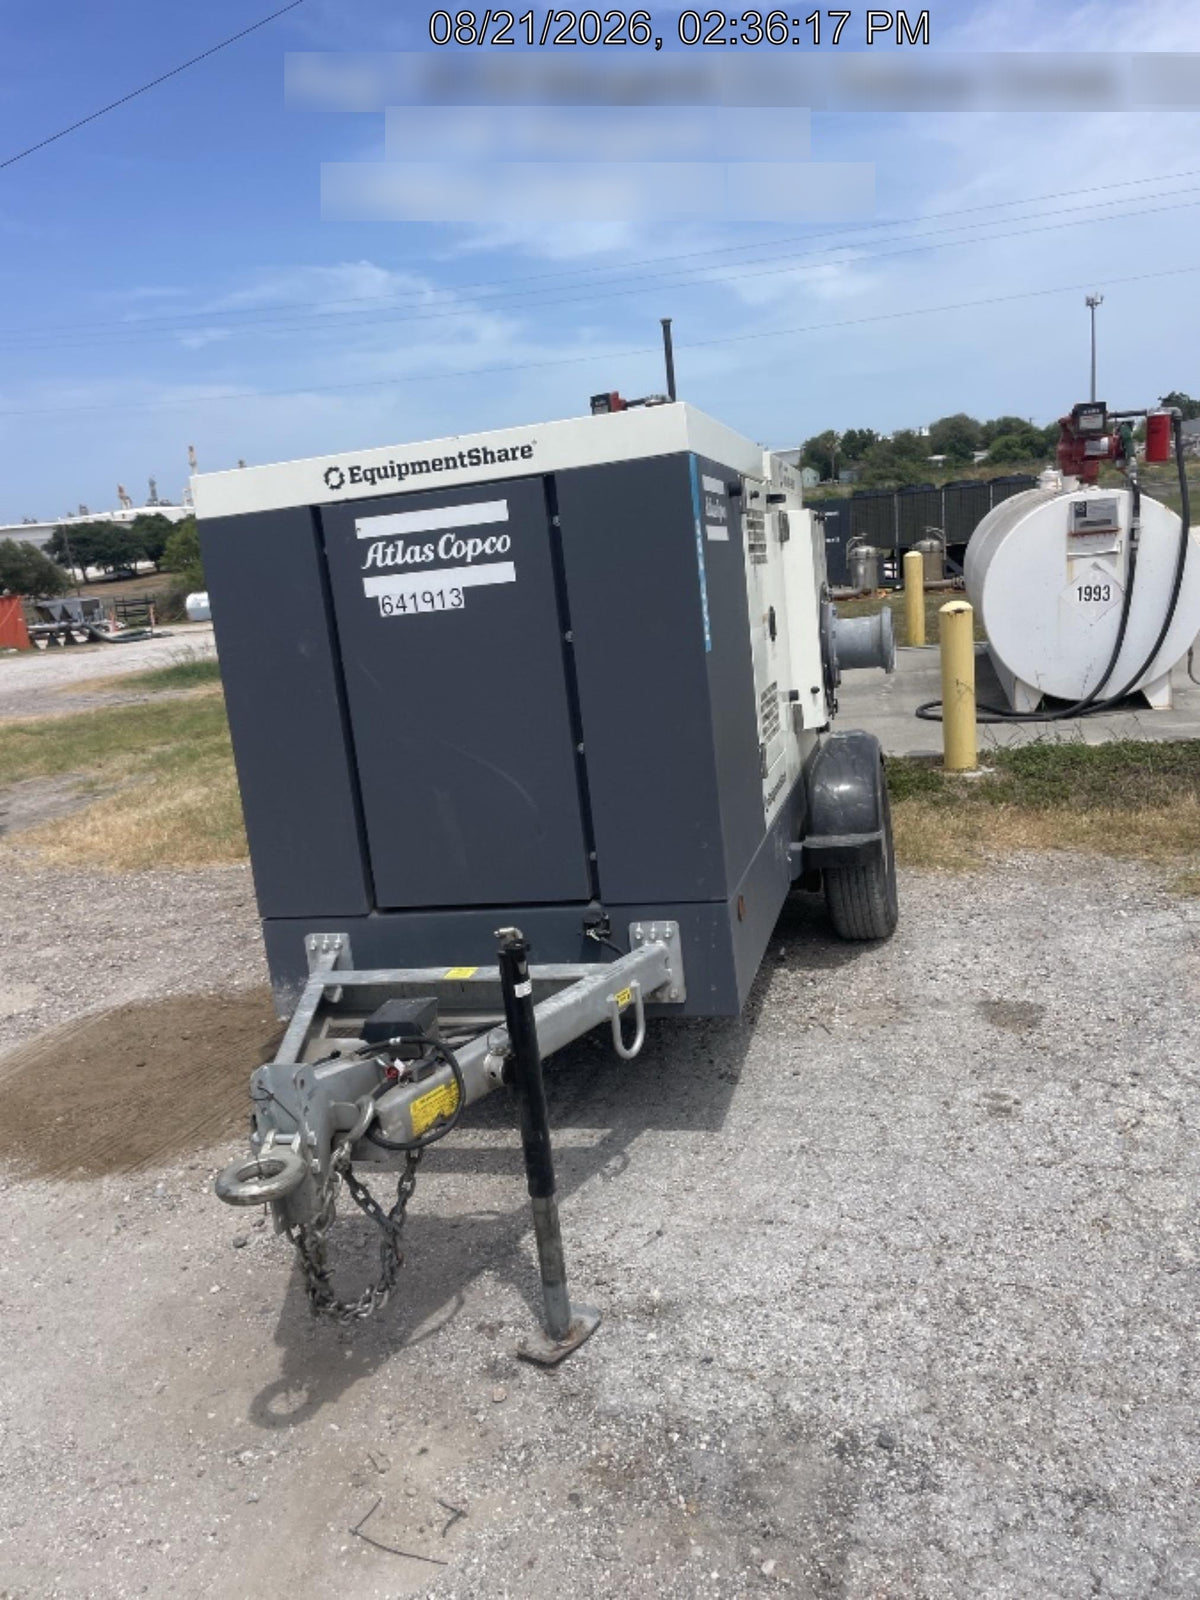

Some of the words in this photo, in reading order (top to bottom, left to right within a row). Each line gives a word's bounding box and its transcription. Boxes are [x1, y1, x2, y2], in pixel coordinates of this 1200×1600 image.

[348, 443, 533, 486] EquipmentShare
[361, 539, 435, 570] Atlas
[437, 532, 511, 562] Copco
[380, 587, 464, 616] 641913
[1077, 584, 1111, 602] 1993
